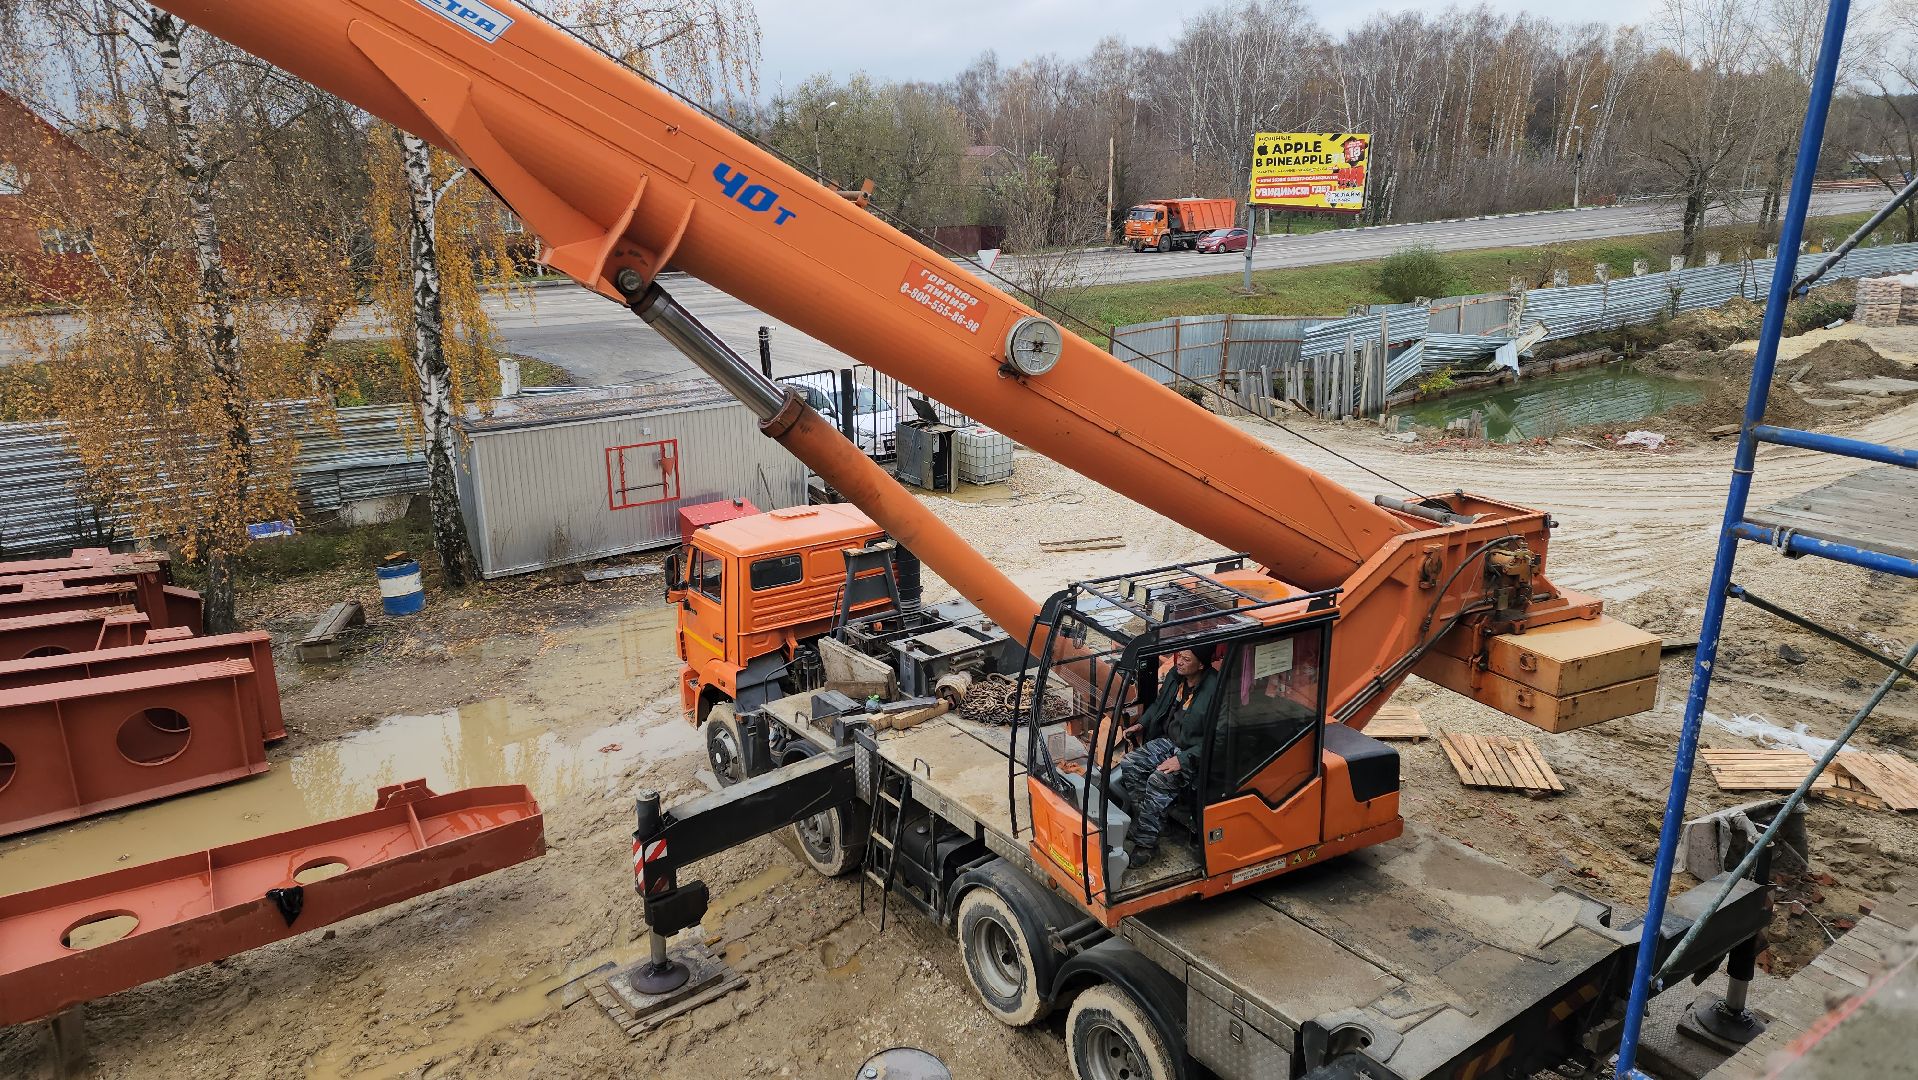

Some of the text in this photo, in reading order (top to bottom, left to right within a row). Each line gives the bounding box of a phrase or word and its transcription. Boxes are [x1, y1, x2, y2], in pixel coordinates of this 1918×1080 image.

[1272, 141, 1322, 155] APPLE
[1266, 154, 1333, 167] PINEAPPLE
[920, 269, 979, 306] ГОРЯЧАЯ
[922, 283, 968, 312] ЛИНИЯ
